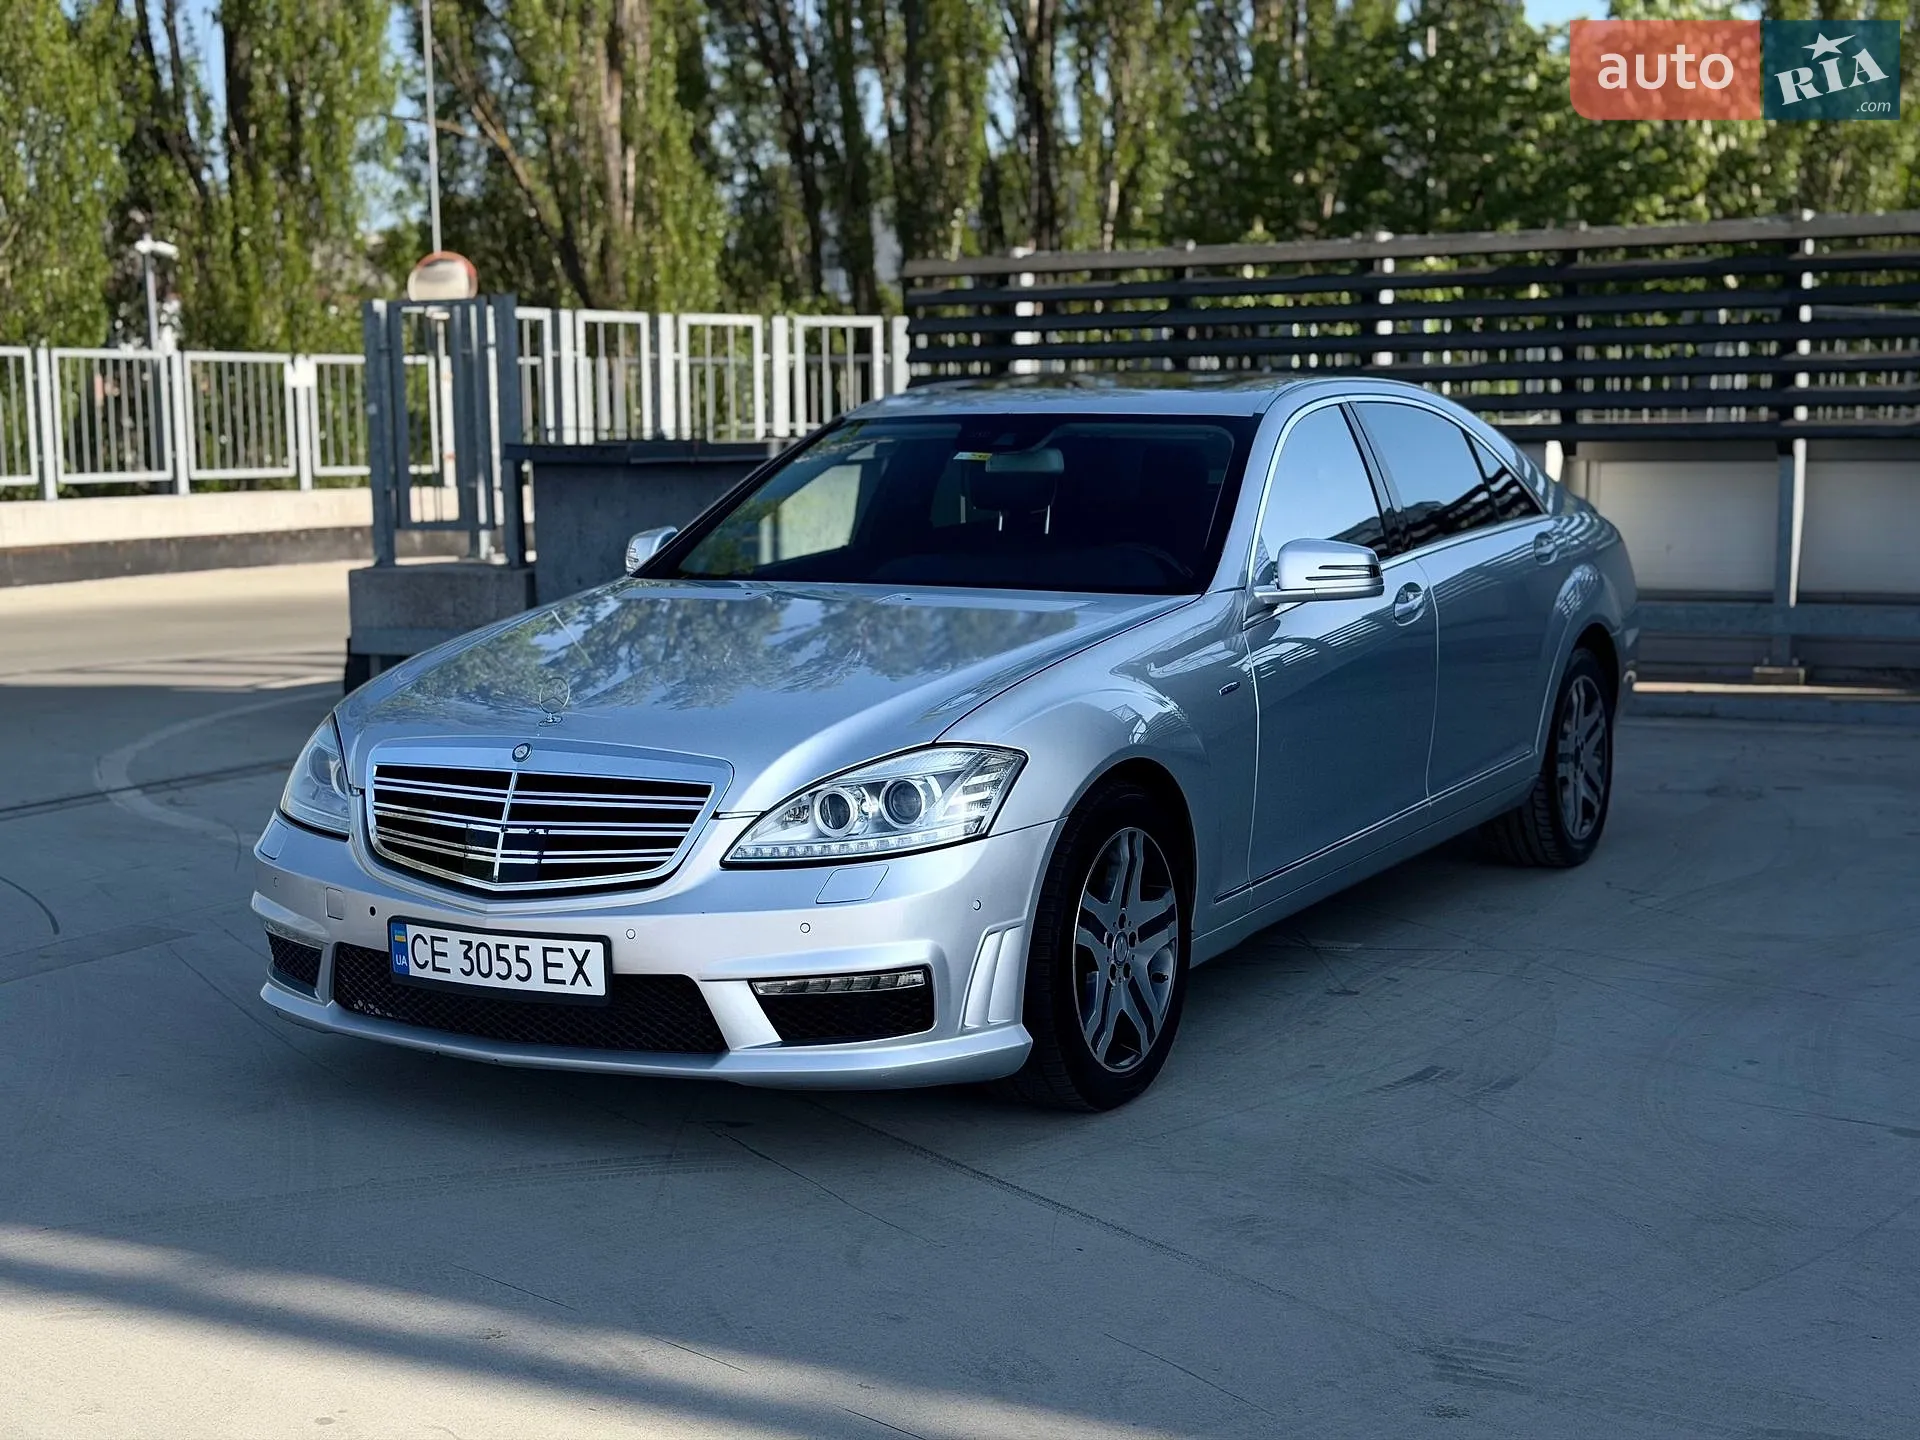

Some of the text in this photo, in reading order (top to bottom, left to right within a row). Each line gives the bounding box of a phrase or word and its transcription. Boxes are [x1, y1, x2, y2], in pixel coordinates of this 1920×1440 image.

[395, 955, 408, 967] UA
[411, 933, 593, 987] CE 3055 EX
